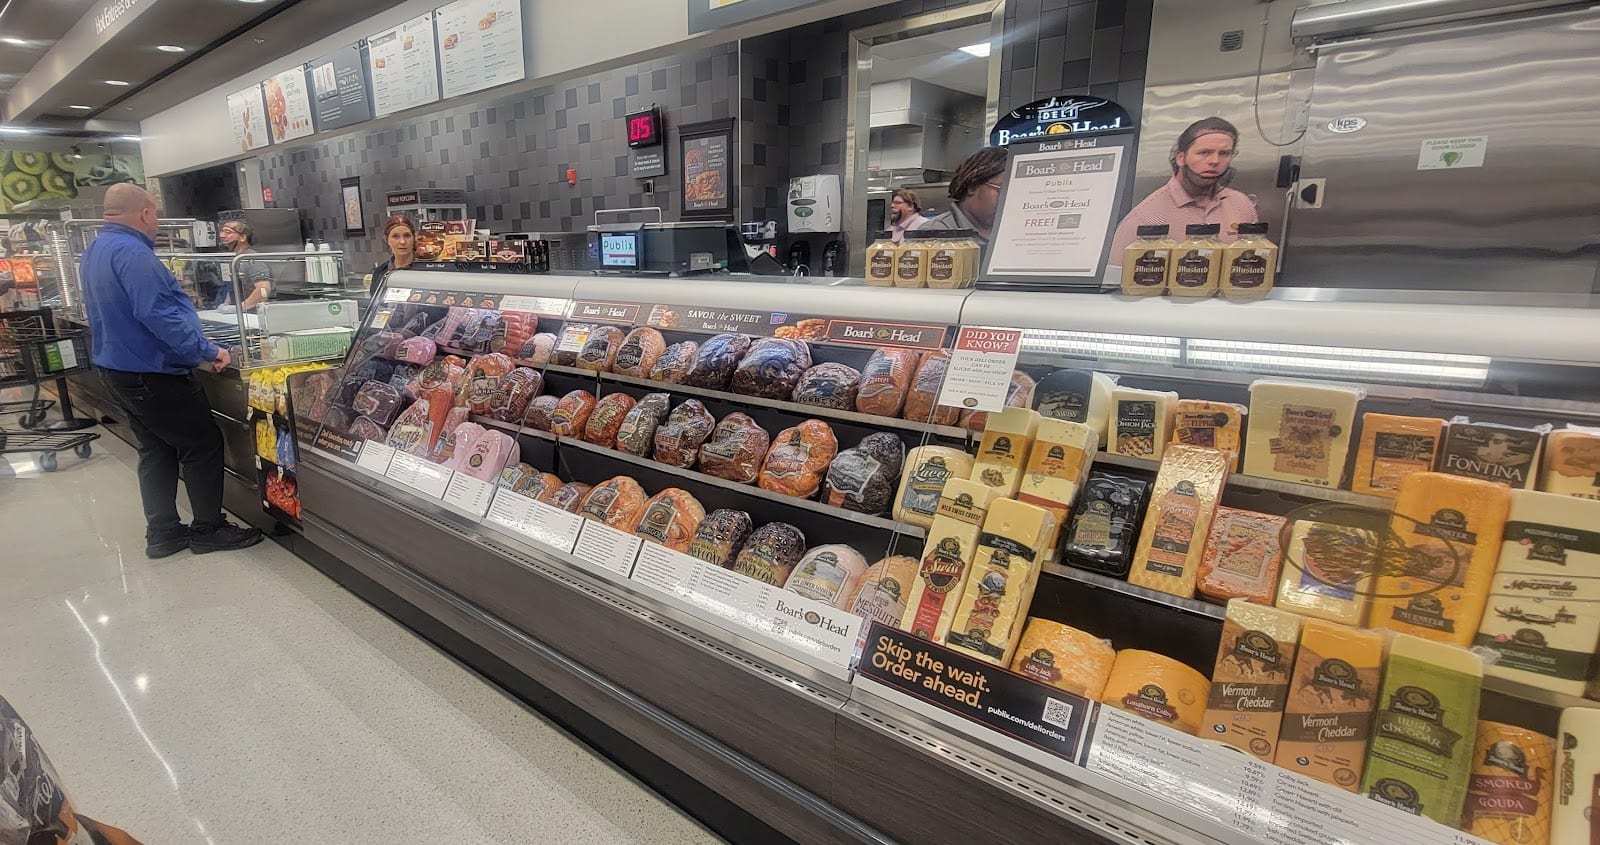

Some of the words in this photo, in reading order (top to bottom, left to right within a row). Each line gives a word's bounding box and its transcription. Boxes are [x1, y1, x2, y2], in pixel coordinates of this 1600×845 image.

[1043, 108, 1075, 121] DELI
[630, 116, 651, 141] 05
[1337, 118, 1357, 129] kps
[1039, 142, 1062, 152] Boar's
[1074, 138, 1097, 148] Head
[1026, 162, 1056, 176] Boar's
[1072, 159, 1104, 173] Head
[1022, 200, 1050, 211] Boar's
[1064, 199, 1091, 208] Head
[1024, 217, 1055, 228] FREE!
[603, 239, 633, 251] Publix
[1135, 265, 1165, 273] Mustard
[1177, 265, 1209, 274] Mustard
[1231, 265, 1265, 274] Mustard
[583, 305, 602, 315] Boar's
[608, 307, 626, 318] Head
[687, 309, 715, 320] SAVOR
[730, 314, 761, 324] SWEET
[843, 325, 874, 339] Boar's
[890, 328, 922, 343] Head
[966, 330, 988, 340] DID
[990, 332, 1016, 342] YOU
[966, 340, 1010, 351] KNOW?
[1115, 420, 1140, 428] ONION
[1140, 421, 1158, 429] JACK
[911, 464, 953, 483] Lacey
[1446, 454, 1524, 482] FONTINA
[1525, 528, 1558, 539] MOZZARELLA
[1558, 532, 1579, 541] CHEESE
[925, 559, 959, 575] Swiss
[776, 600, 804, 620] Boar's
[819, 615, 849, 637] Head
[857, 599, 900, 628] MESQUITE
[1400, 610, 1445, 627] MUENSTER
[1239, 643, 1260, 659] Boar's
[1260, 651, 1276, 664] Head
[876, 635, 912, 662] Skip
[915, 651, 945, 674] the
[947, 665, 991, 694] wait.
[1024, 662, 1040, 674] Colby
[871, 654, 922, 684] Order
[922, 674, 983, 710] ahead.
[1318, 673, 1338, 687] Boar's
[1338, 679, 1356, 691] Head
[1221, 683, 1258, 697] Vermont
[1126, 698, 1156, 715] Longhorn
[1156, 706, 1173, 718] Colby
[1236, 697, 1275, 711] Cheddar
[1395, 702, 1418, 715] Boar's
[1417, 707, 1437, 720] Head
[987, 705, 1067, 743] publix.com/deliorders
[1301, 714, 1338, 728] Vermont
[1317, 727, 1357, 743] Cheddar
[1278, 771, 1296, 782] Colby
[1275, 785, 1296, 797] Cream
[1277, 778, 1297, 790] Cream
[1475, 778, 1533, 791] SMOKED
[1273, 792, 1294, 804] Cream
[1478, 798, 1524, 810] GOUDA
[1397, 801, 1417, 814] Head
